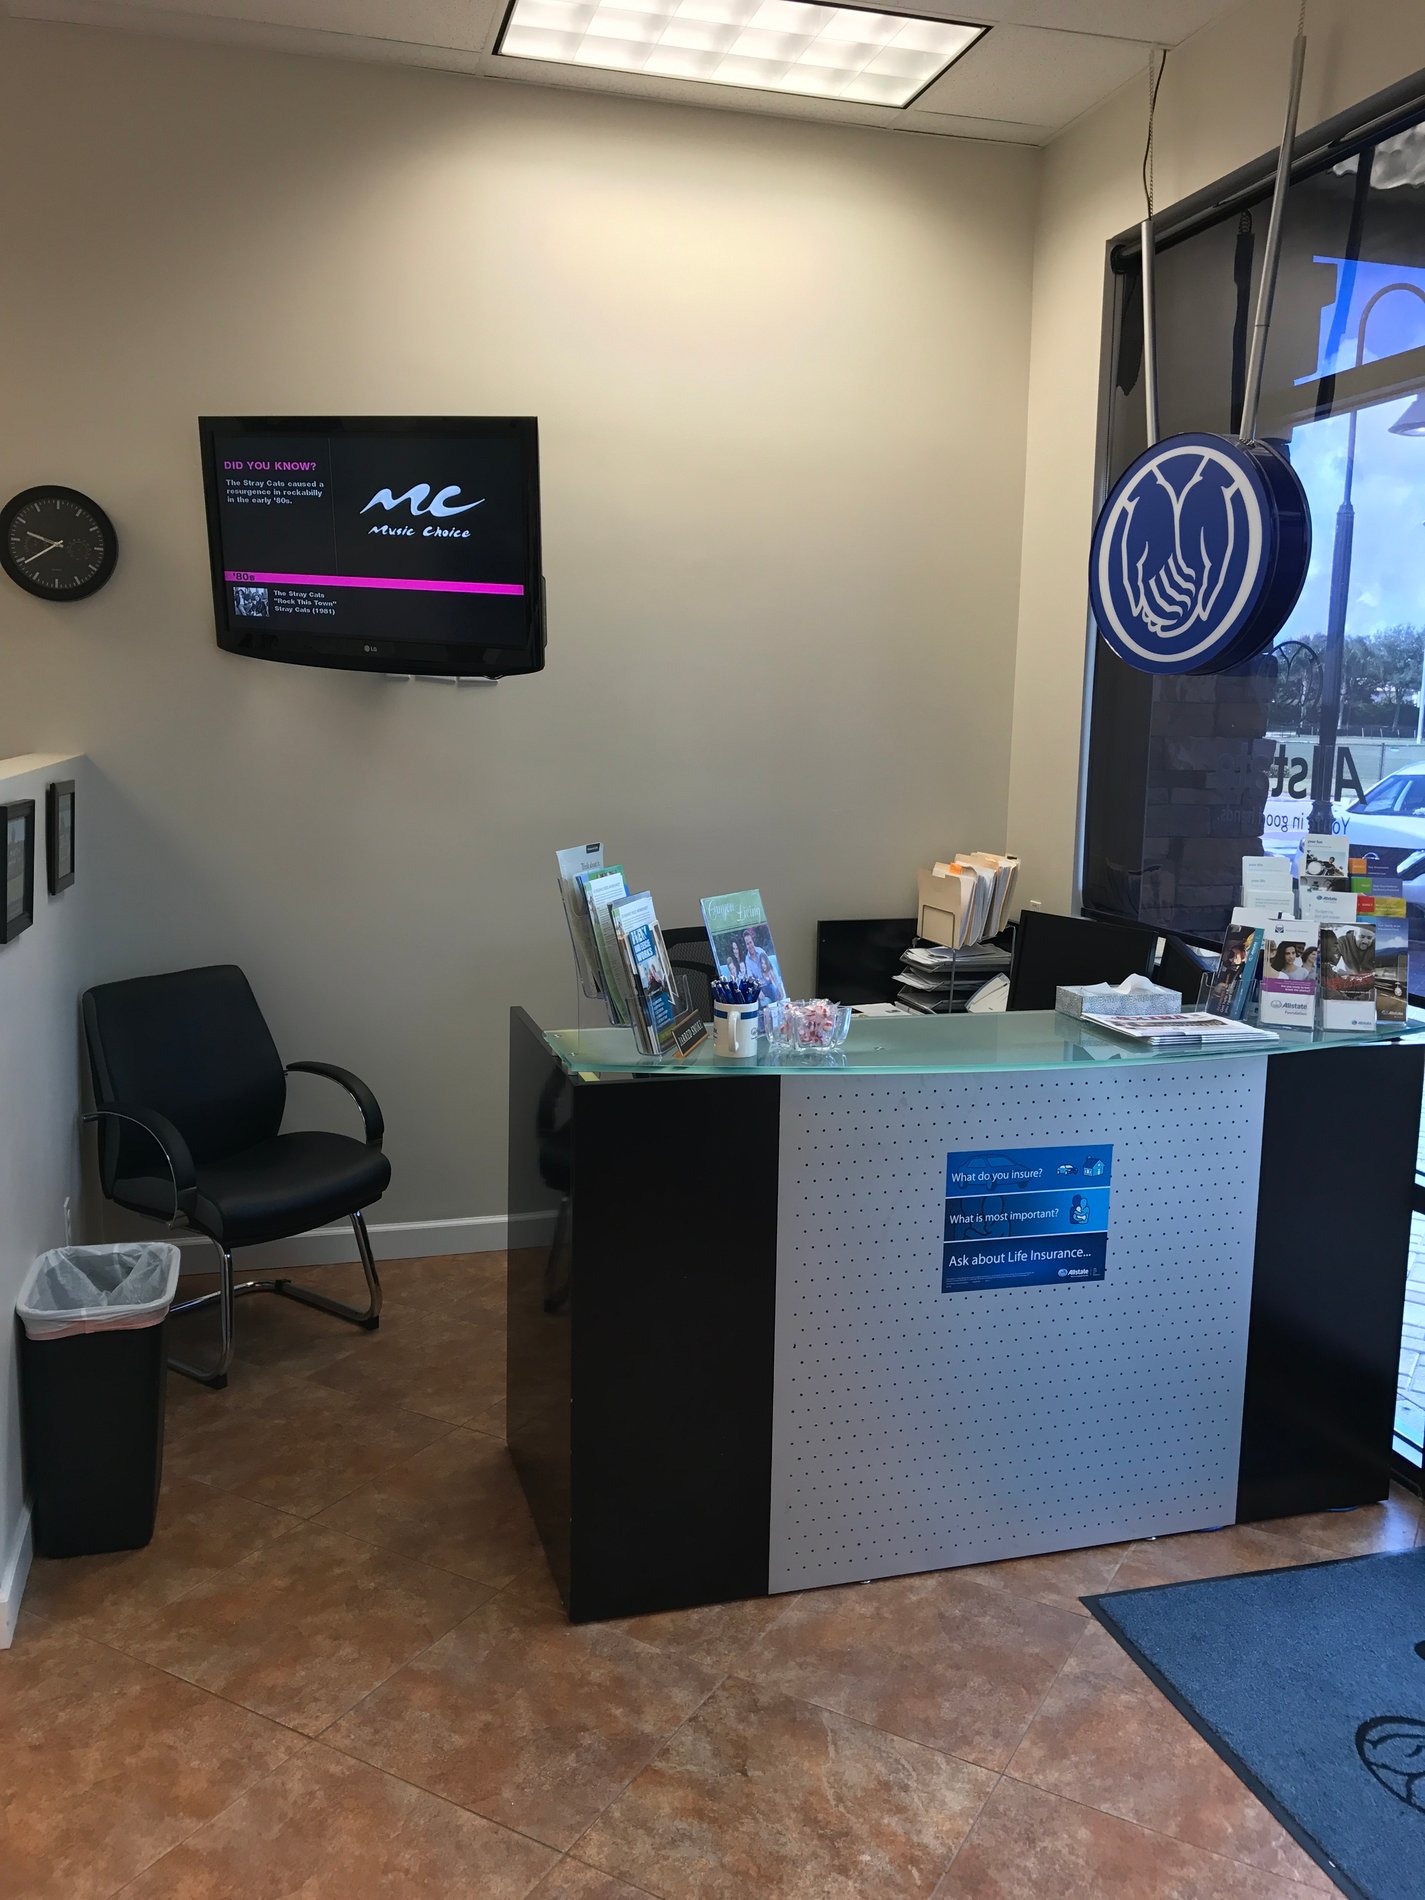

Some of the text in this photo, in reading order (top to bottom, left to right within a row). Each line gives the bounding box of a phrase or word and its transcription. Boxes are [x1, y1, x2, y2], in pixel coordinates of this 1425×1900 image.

[224, 461, 316, 471] DID YOU KNOW?
[243, 480, 264, 488] Stray
[283, 489, 322, 498] rockabilly
[252, 497, 271, 505] early
[368, 524, 471, 538] Music Choice
[232, 572, 255, 581] '80s
[951, 1168, 1043, 1182] What do you insure?
[949, 1208, 1059, 1224] What is most important?
[949, 1248, 1092, 1267] Ask about Life Insurance...
